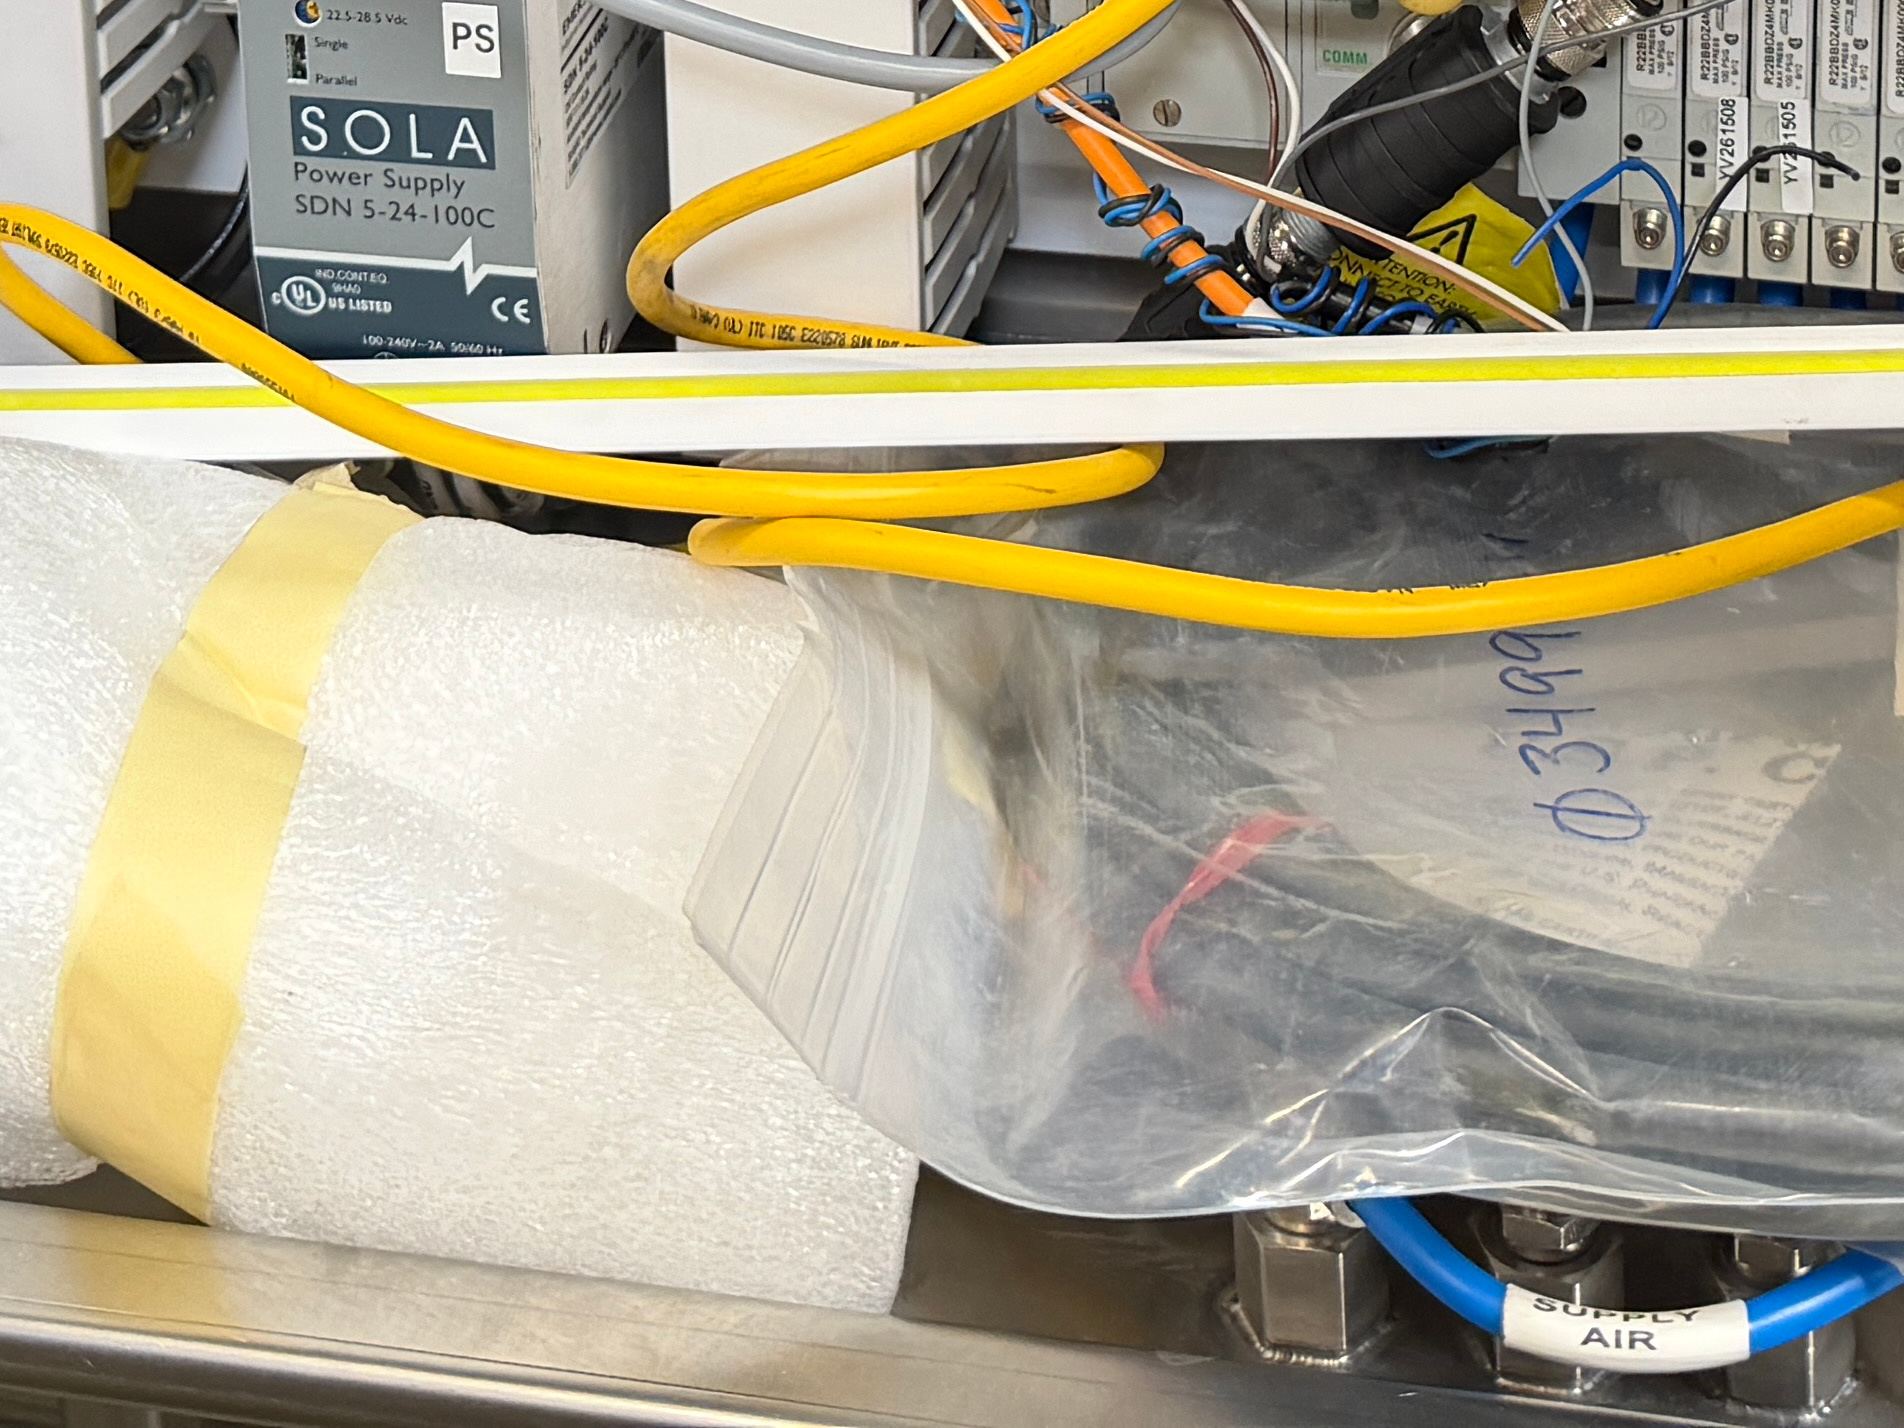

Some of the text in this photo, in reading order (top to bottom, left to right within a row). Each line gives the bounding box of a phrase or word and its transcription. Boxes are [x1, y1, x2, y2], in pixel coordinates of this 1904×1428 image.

[385, 13, 408, 26] Vdc
[314, 36, 348, 51] Single
[452, 22, 495, 53] PS
[1322, 49, 1368, 65] COMM
[315, 73, 357, 87] Parallel
[300, 105, 489, 164] SOLA
[1719, 98, 1736, 180] YV261508
[294, 162, 466, 198] Power Supply
[296, 195, 496, 229] SDN 5-24-100C
[1375, 256, 1457, 294] TENTION:
[349, 300, 392, 313] LISTED
[491, 296, 530, 324] CE
[1580, 1327, 1657, 1350] AIR
